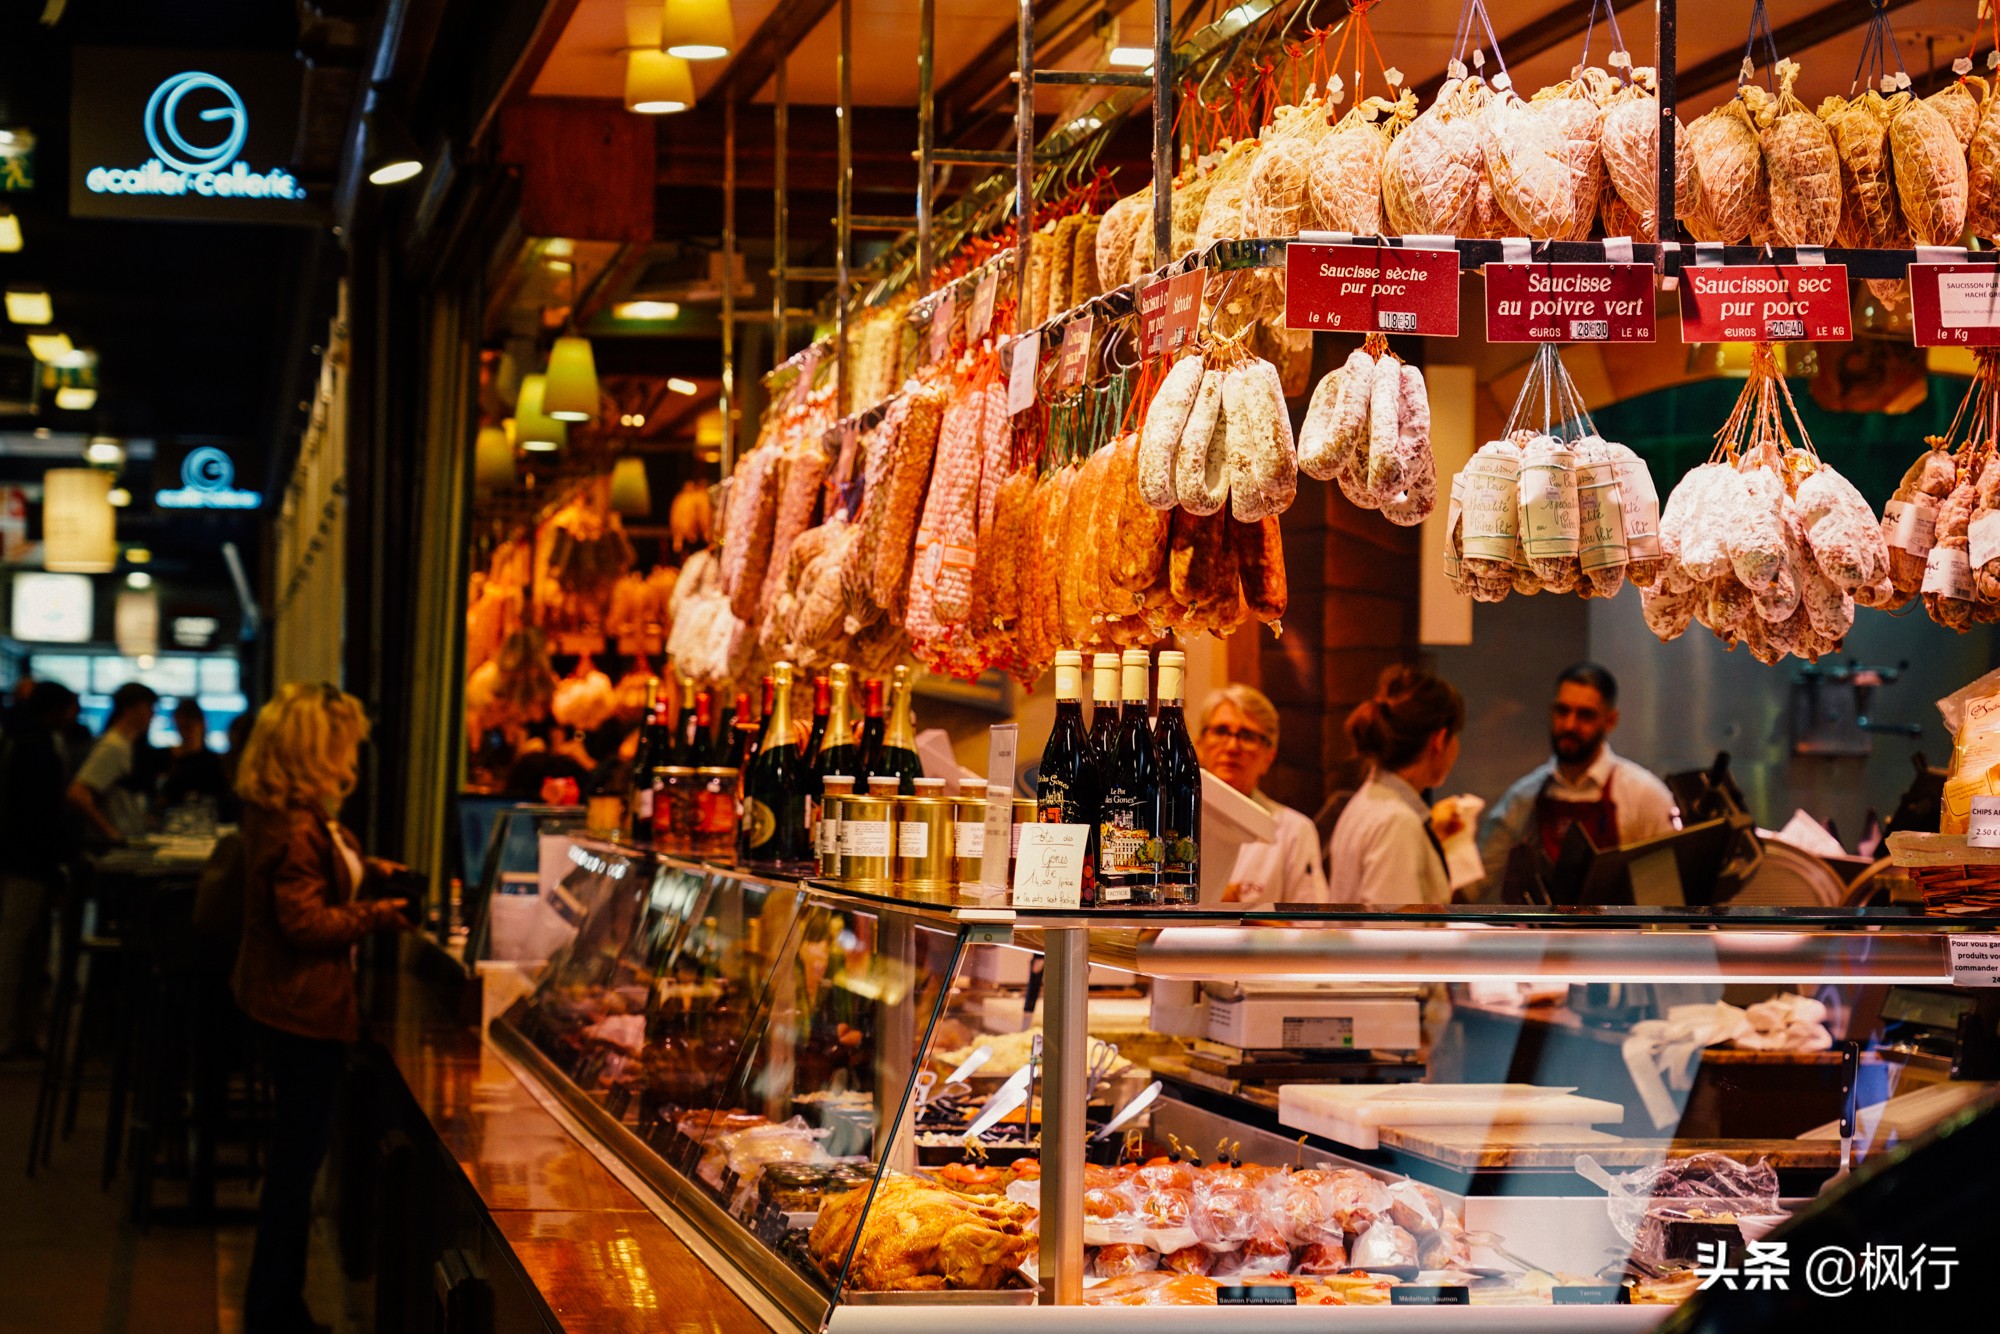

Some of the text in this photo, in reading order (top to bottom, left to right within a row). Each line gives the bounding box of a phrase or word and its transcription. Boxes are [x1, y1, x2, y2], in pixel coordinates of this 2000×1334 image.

[1319, 263, 1428, 281] Saucisse sèche
[1340, 282, 1406, 297] pur porc
[1528, 273, 1612, 292] Saucisse
[1694, 276, 1832, 294] Saucisson sec
[1498, 297, 1643, 320] au poivre vert
[1720, 300, 1810, 320] pur porc
[1308, 311, 1320, 323] le
[1326, 312, 1341, 326] Kg
[1621, 327, 1632, 338] LE
[1637, 327, 1649, 338] KG
[1816, 326, 1828, 336] LE
[1832, 326, 1845, 336] KG
[1937, 328, 1968, 342] le Kg
[1972, 808, 1991, 816] CHIPS
[1976, 828, 1992, 836] 2.50
[1958, 952, 1988, 960] produits
